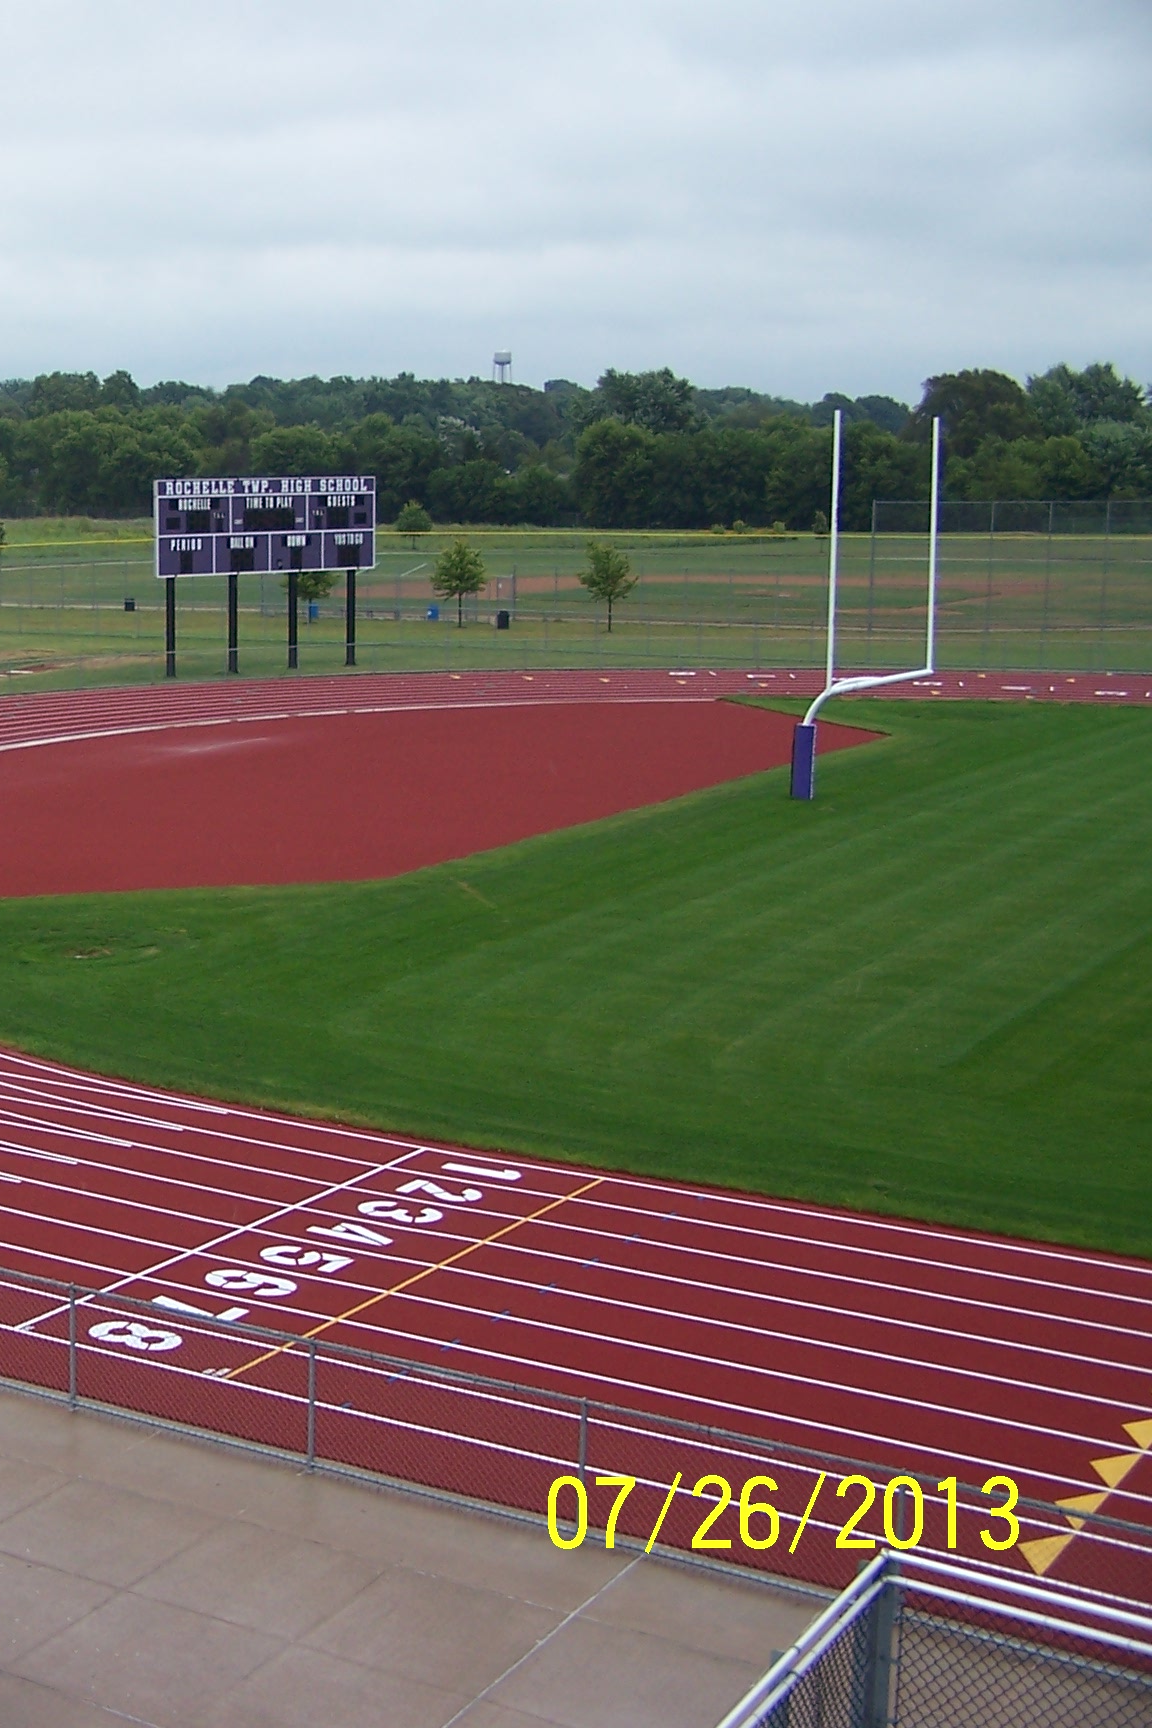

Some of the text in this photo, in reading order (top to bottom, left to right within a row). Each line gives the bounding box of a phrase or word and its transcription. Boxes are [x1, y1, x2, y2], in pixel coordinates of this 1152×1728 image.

[166, 479, 367, 495] ROCHELLE TWP. HIGH SCHOOL
[178, 498, 211, 511] ROCHELLE
[246, 496, 293, 509] TIME TO PLAY
[327, 495, 356, 507] GUESTS
[170, 538, 202, 551] PERIOD
[287, 535, 306, 547] DOWN
[88, 1162, 522, 1351] 1 2 3 4 5 6 7 8
